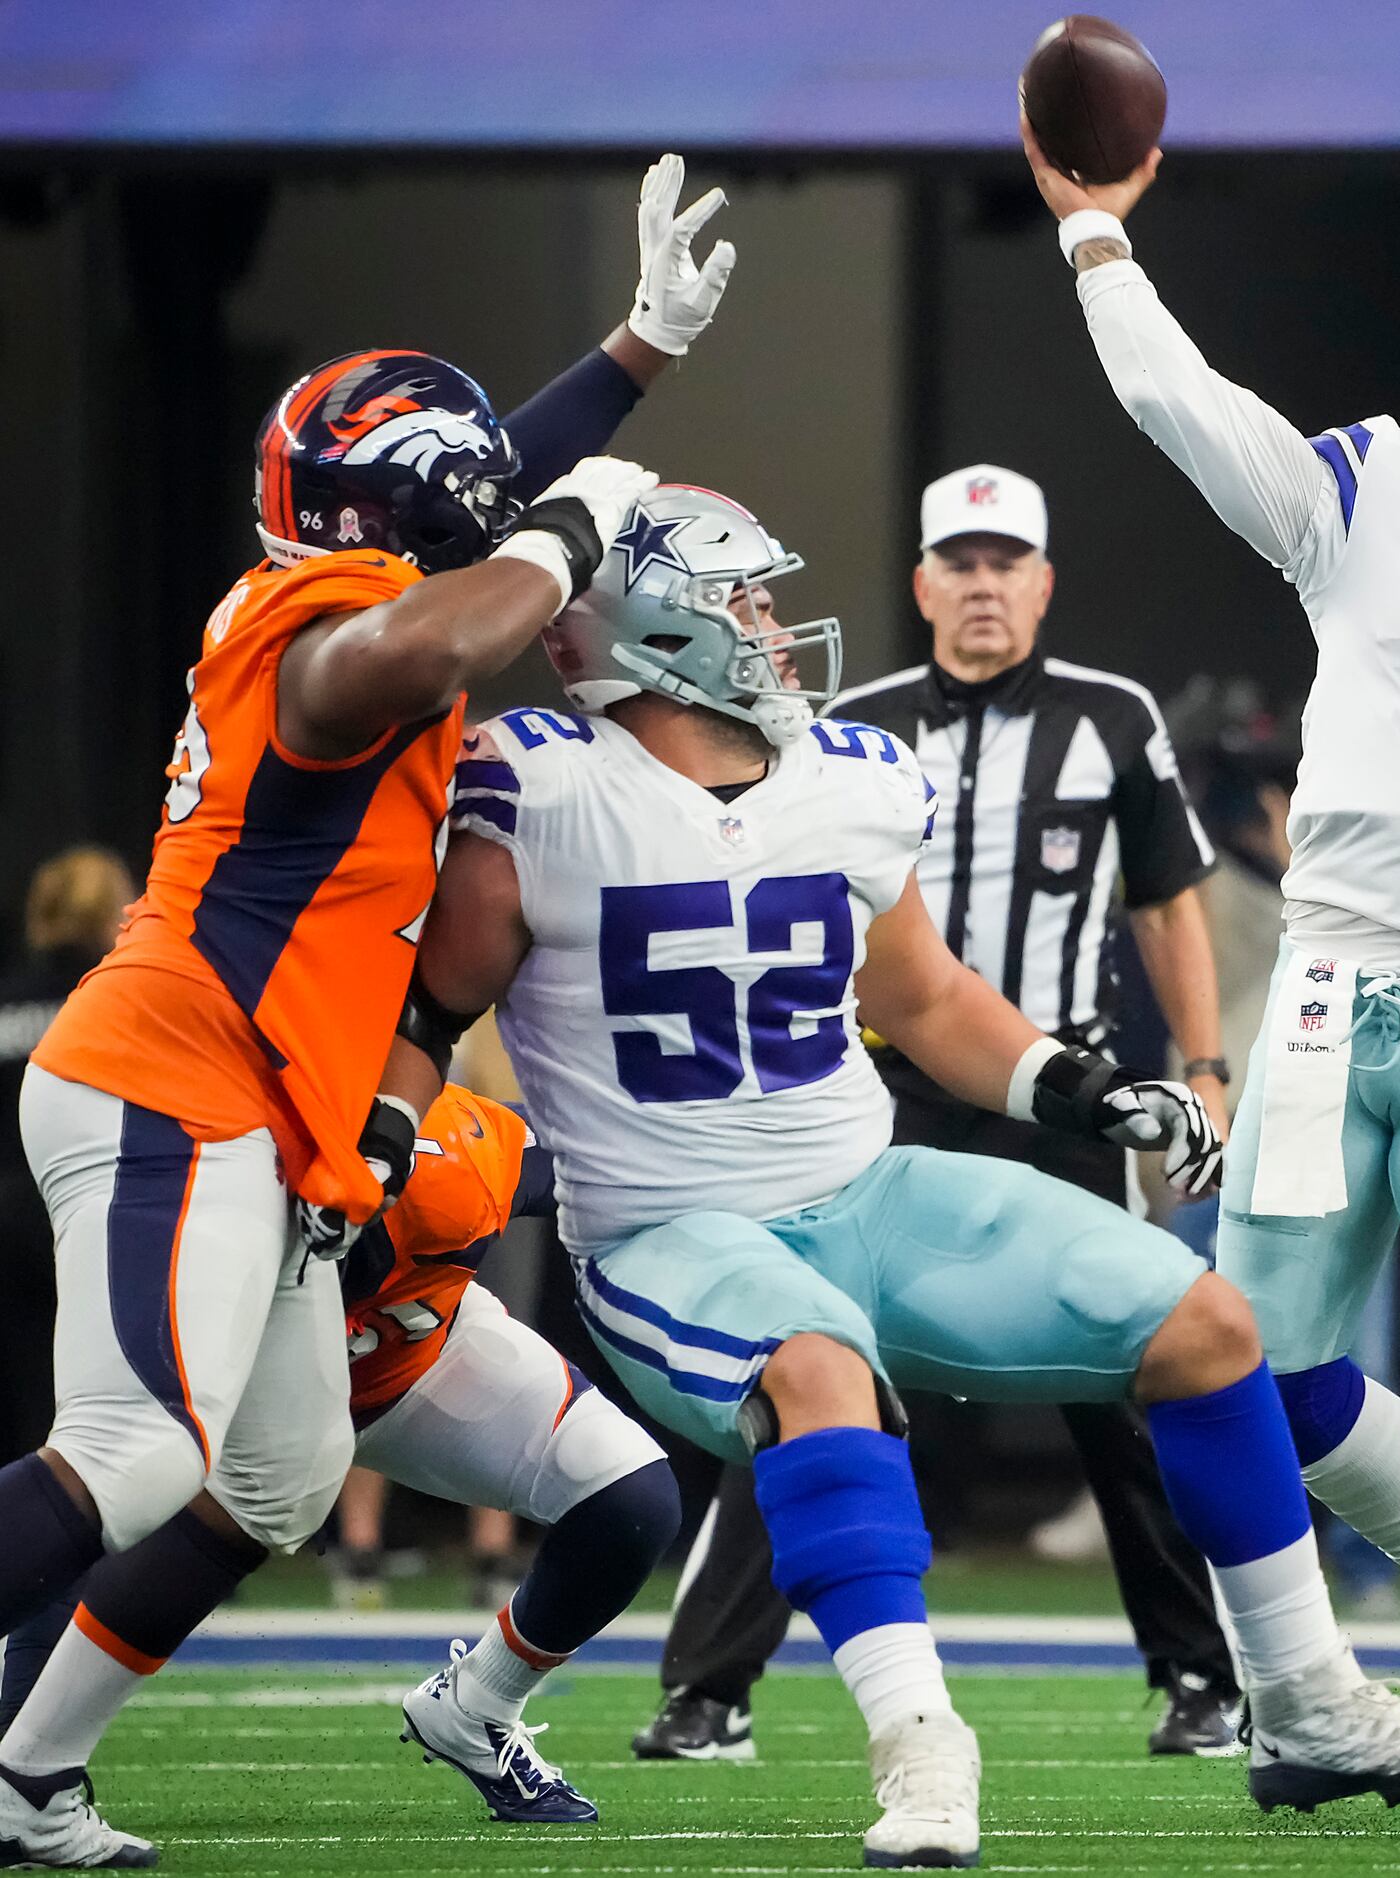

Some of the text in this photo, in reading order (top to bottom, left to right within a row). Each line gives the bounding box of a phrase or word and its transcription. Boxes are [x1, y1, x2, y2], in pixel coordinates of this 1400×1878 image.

[299, 510, 324, 531] 96
[600, 872, 857, 1103] 52
[1301, 1016, 1325, 1031] NFL
[1287, 1042, 1330, 1054] Wilson
